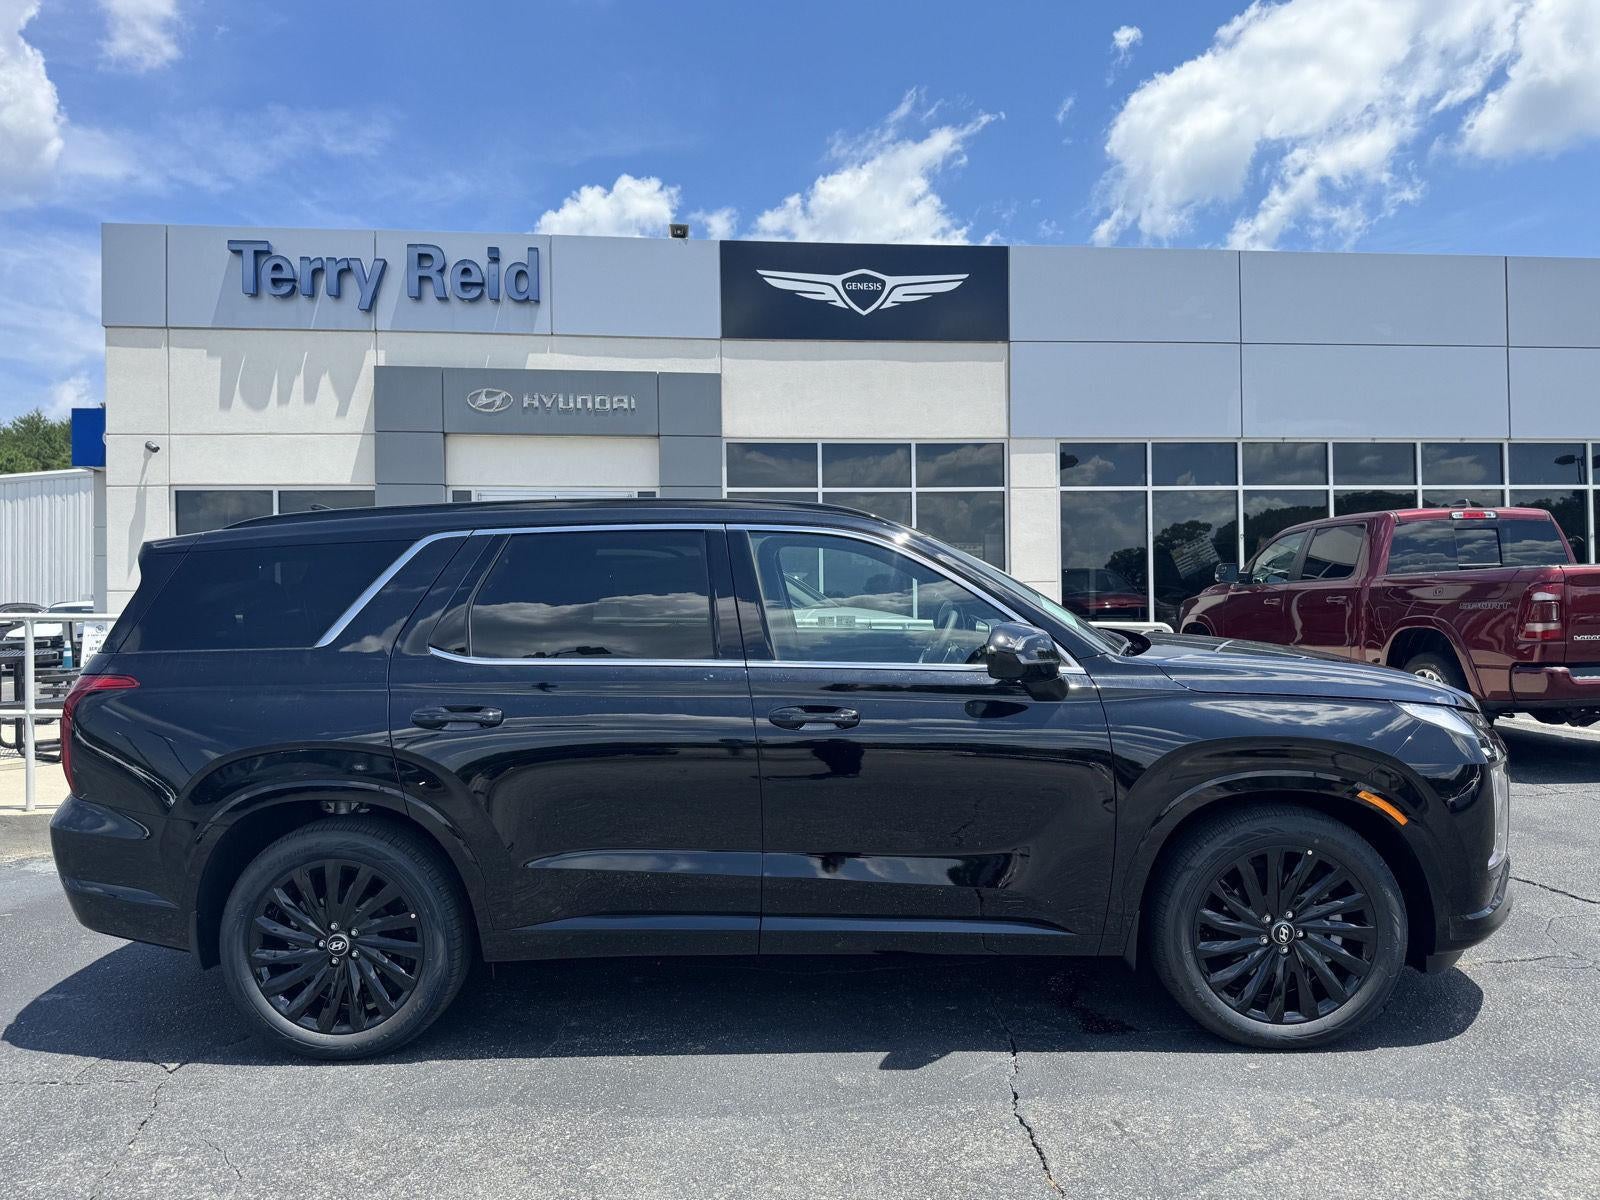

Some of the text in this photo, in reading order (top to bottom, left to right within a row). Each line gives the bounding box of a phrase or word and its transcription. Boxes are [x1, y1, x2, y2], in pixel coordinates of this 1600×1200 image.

[227, 240, 541, 312] Terry Reid
[845, 282, 882, 291] GENESIS
[522, 392, 636, 412] HYUNDAI
[1459, 601, 1511, 610] SPORT
